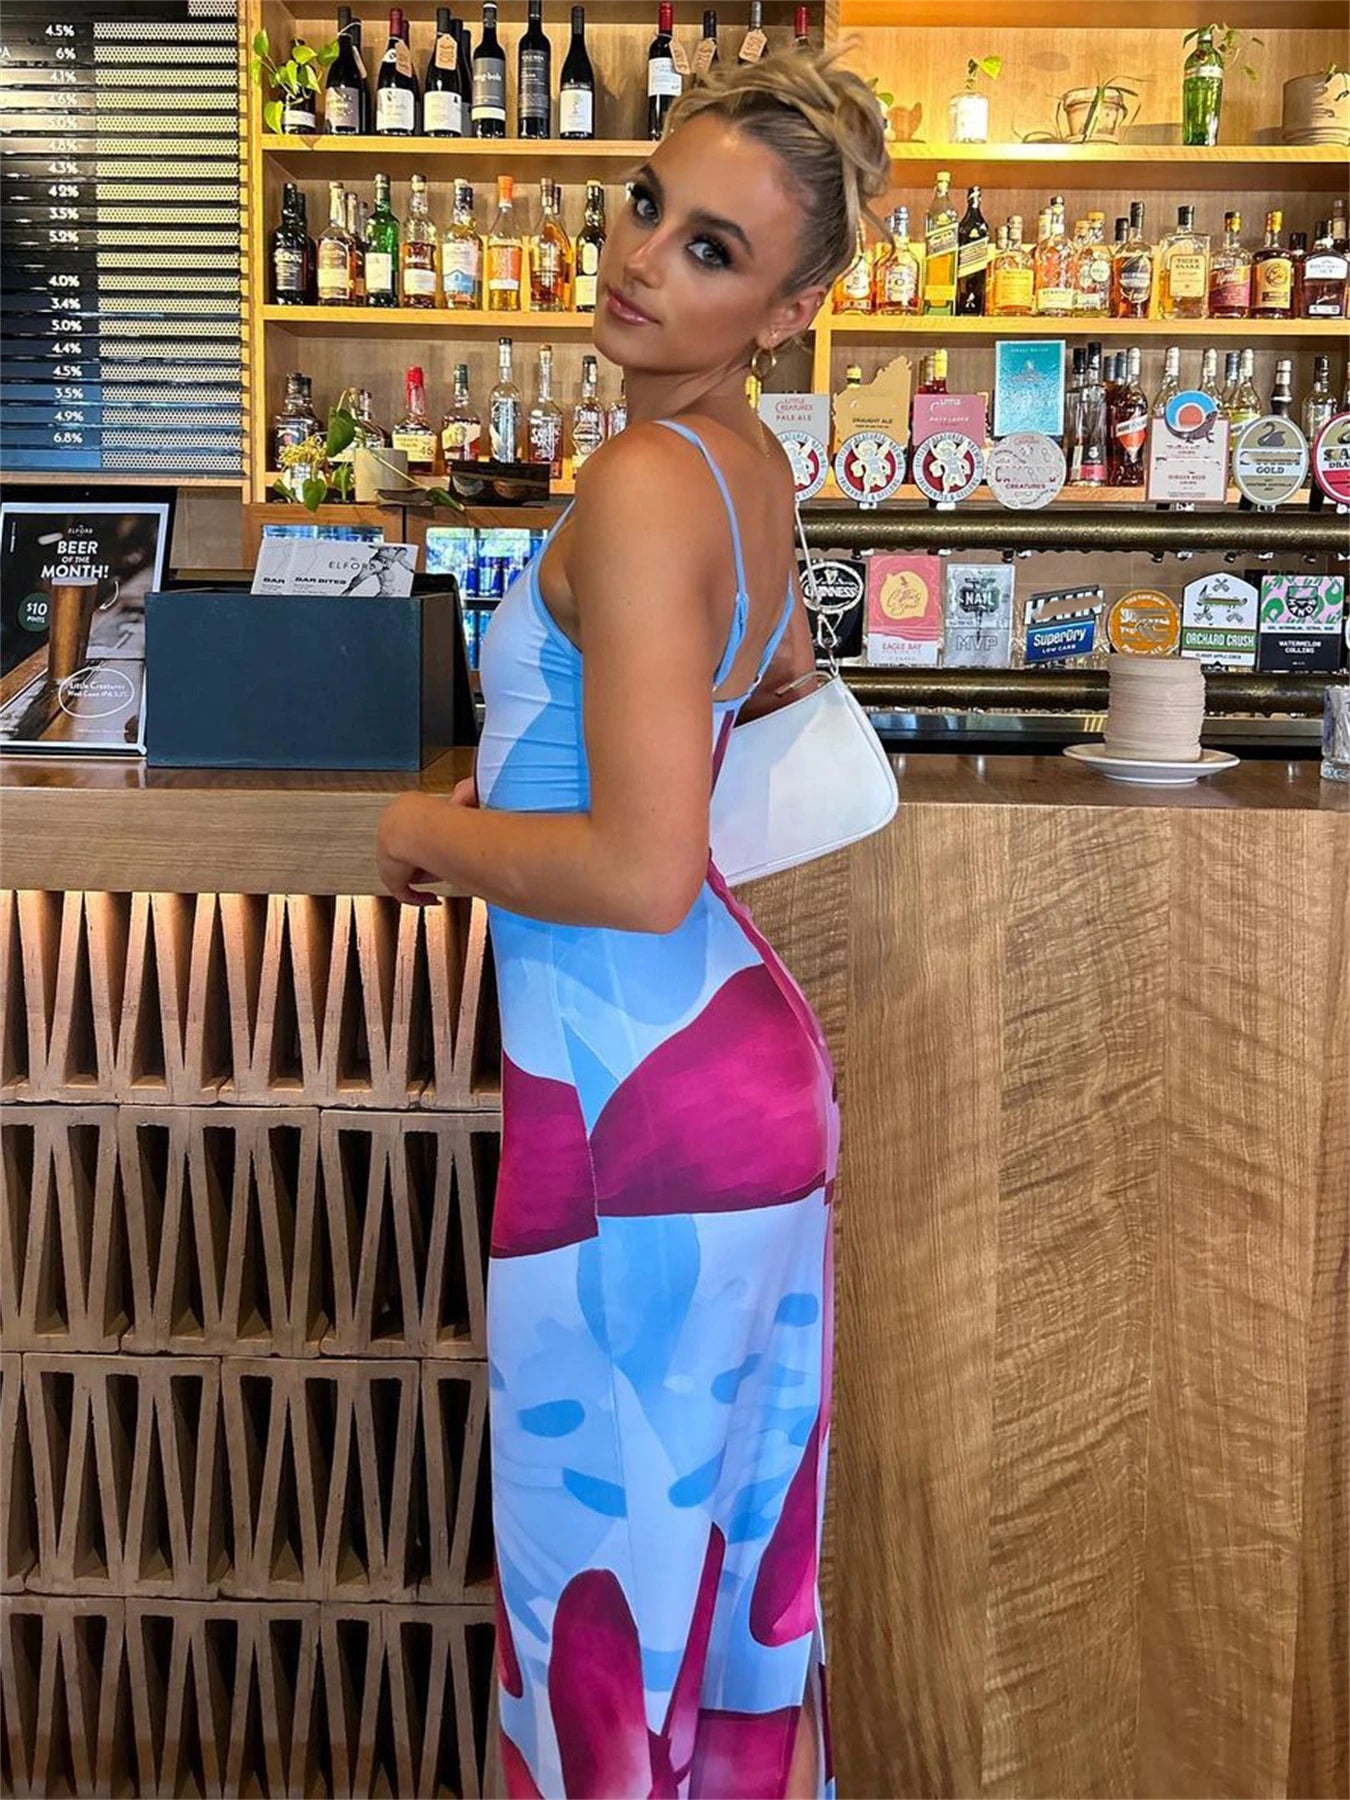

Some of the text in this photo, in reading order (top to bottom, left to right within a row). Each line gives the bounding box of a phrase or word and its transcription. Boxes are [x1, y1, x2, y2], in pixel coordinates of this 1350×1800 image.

[45, 25, 75, 37] 4.5%
[56, 48, 76, 59] 6%
[49, 275, 80, 287] 4.0%
[51, 298, 81, 310] 3.4%
[51, 320, 82, 332] 5.0%
[52, 343, 82, 354] 4.4%
[53, 366, 82, 377] 4.5%
[55, 388, 83, 399] 3.5%
[54, 410, 84, 421] 4.9%
[53, 432, 83, 443] 6.8%
[1256, 466, 1285, 474] GOLD
[57, 540, 98, 555] BEER
[61, 556, 90, 564] OF THE
[41, 564, 110, 579] MONTH!
[263, 577, 286, 585] BAR
[295, 576, 316, 584] BAR
[964, 591, 995, 605] NAIL
[26, 602, 48, 616] $10
[955, 634, 998, 651] MVP
[1186, 632, 1255, 647] ORCHARD CRUSH
[1041, 646, 1056, 654] LOW
